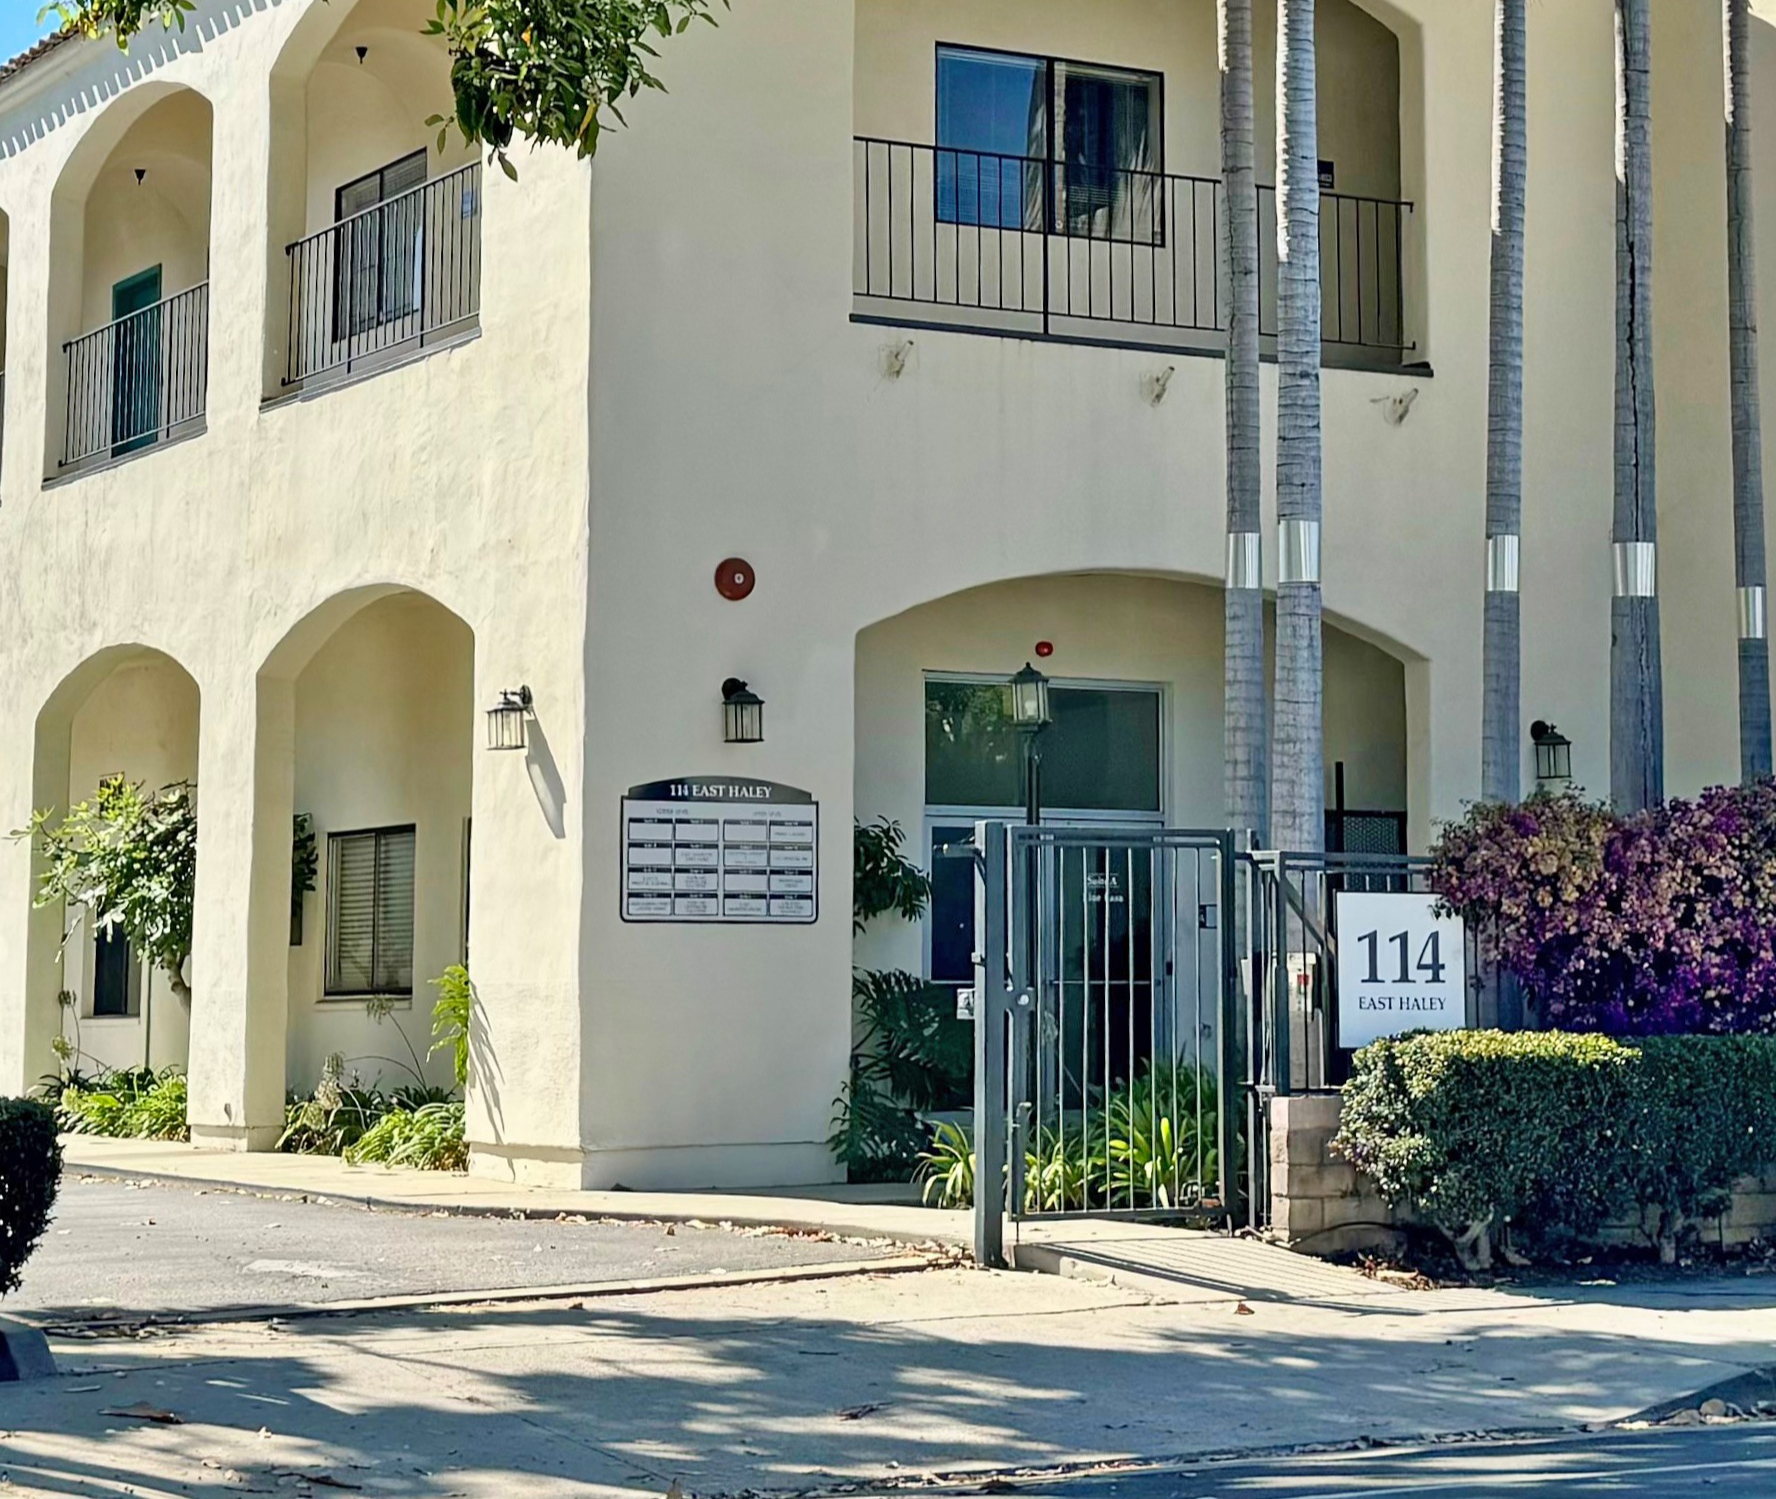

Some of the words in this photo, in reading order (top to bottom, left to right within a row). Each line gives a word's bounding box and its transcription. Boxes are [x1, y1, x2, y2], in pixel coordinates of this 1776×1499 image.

[670, 784, 688, 797] 114
[692, 785, 725, 797] EAST
[729, 785, 772, 798] HALEY
[1357, 929, 1446, 984] 114
[1359, 996, 1395, 1010] EAST
[1399, 997, 1446, 1011] HALEY
